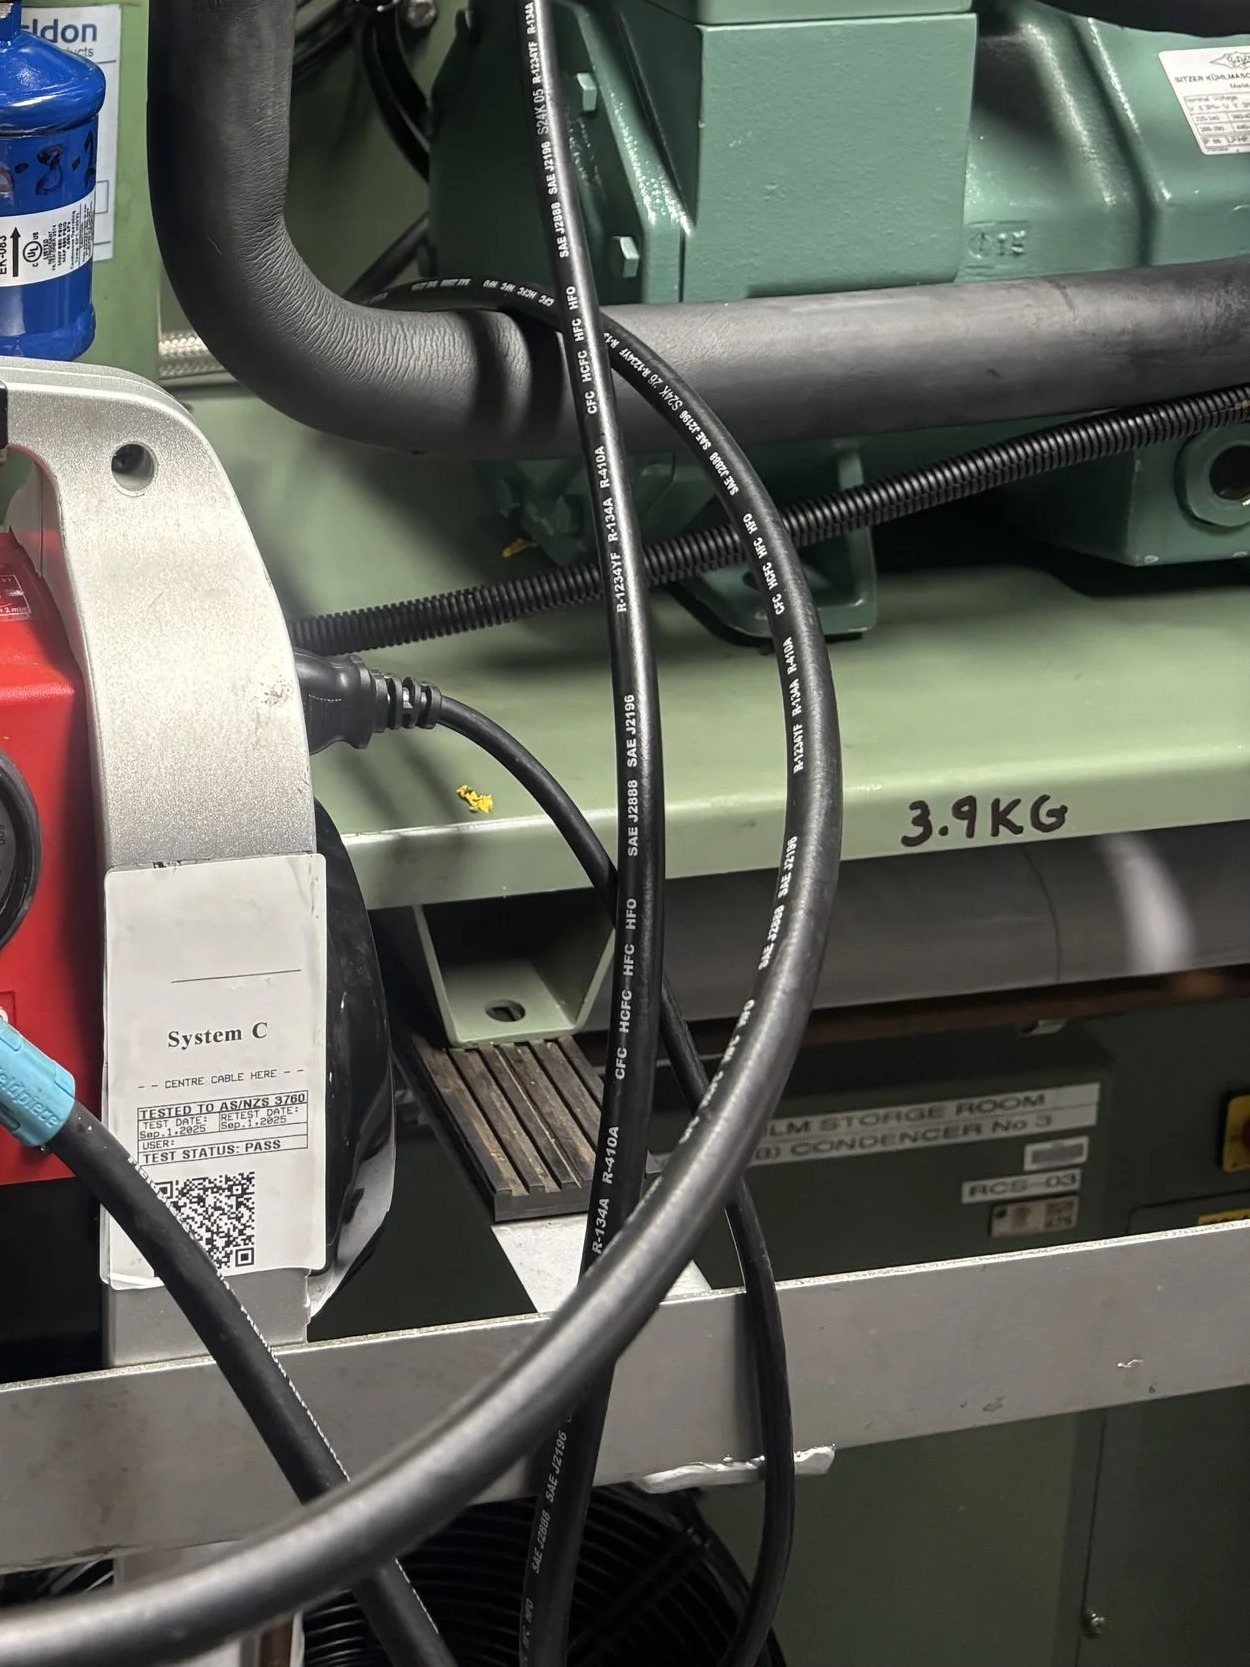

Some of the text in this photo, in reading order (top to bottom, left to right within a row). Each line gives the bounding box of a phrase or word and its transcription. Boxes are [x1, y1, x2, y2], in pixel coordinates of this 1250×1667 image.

[21, 18, 97, 44] ldon
[523, 1, 536, 34] R-134A
[527, 40, 542, 84] R-1234YF
[533, 87, 544, 104] 05
[534, 106, 549, 135] S24K
[540, 140, 570, 258] SAE J2888 SAE J2196
[565, 286, 598, 415] CFC HCFC HFC HFO
[618, 348, 683, 411] S24K R-1234YF
[679, 409, 739, 496] SAE J2888 SAE J2196
[594, 445, 628, 613] R-1234YF R-134A R-410A
[743, 513, 785, 615] CFC HCFC HFC HFO
[783, 636, 804, 774] R-1234YF R-134A R-410A
[623, 694, 638, 768] SAE J2196
[615, 779, 639, 1080] CFC HCFC HFC HFO SAE J2888
[168, 1022, 268, 1050] System C
[164, 1069, 277, 1089] CENTRE CABLE HERE
[140, 1093, 306, 1120] TESTED TO AS/NZS 3760
[143, 1116, 207, 1130] TEST DATE:
[220, 1106, 299, 1121] RETEST DATE:
[820, 1094, 1046, 1133] STORGE ROOM
[142, 1139, 175, 1150] USER:
[142, 1139, 281, 1164] TEST STATUS: PASS
[790, 1117, 1027, 1158] CONDENCER No
[591, 1125, 620, 1255] R-134A R-410A
[545, 1430, 567, 1503] SAE J2196
